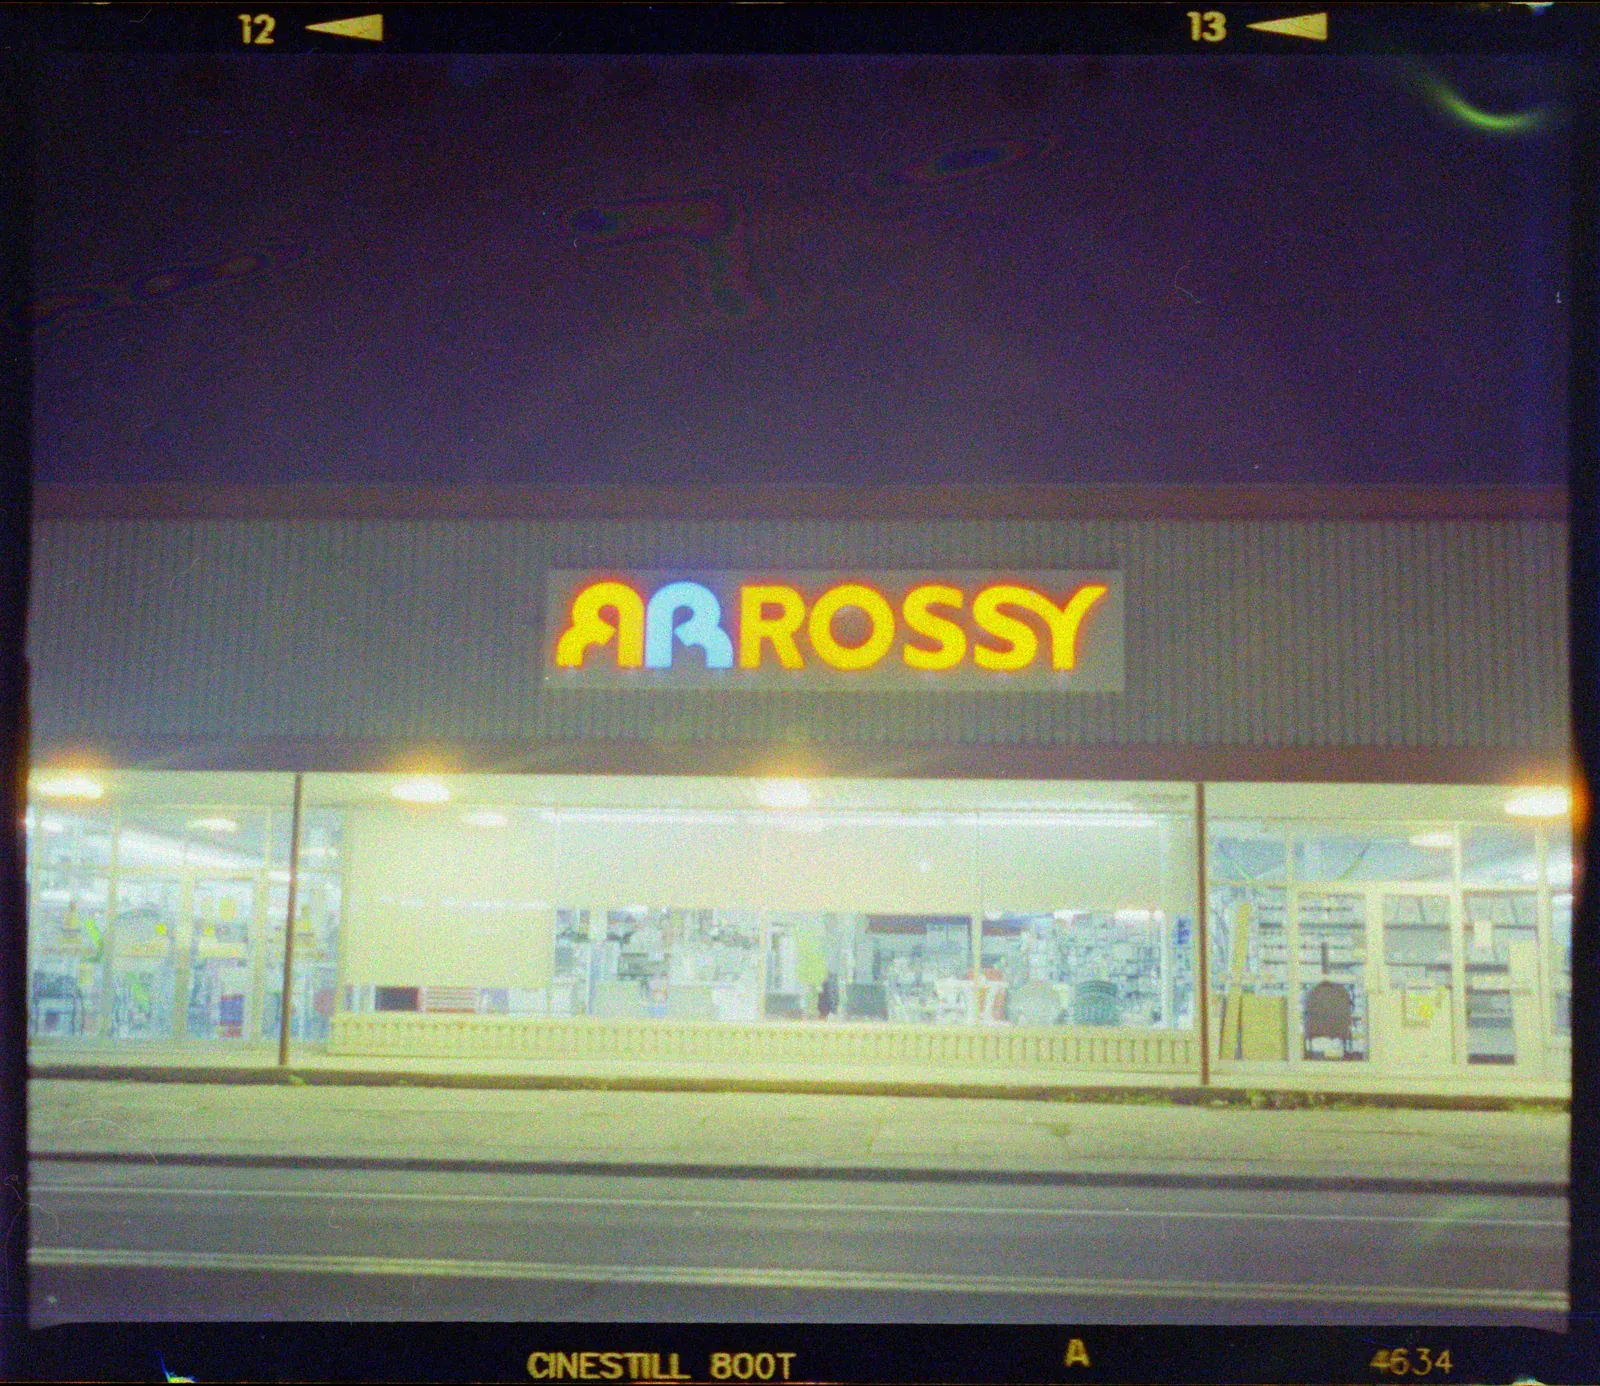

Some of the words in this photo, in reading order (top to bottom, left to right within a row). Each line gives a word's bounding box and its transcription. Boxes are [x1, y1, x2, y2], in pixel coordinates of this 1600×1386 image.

[238, 14, 276, 45] 12
[1186, 11, 1227, 42] 13
[527, 1351, 691, 1379] CINESTILL
[710, 1351, 797, 1379] 800T
[1064, 1339, 1091, 1367] A
